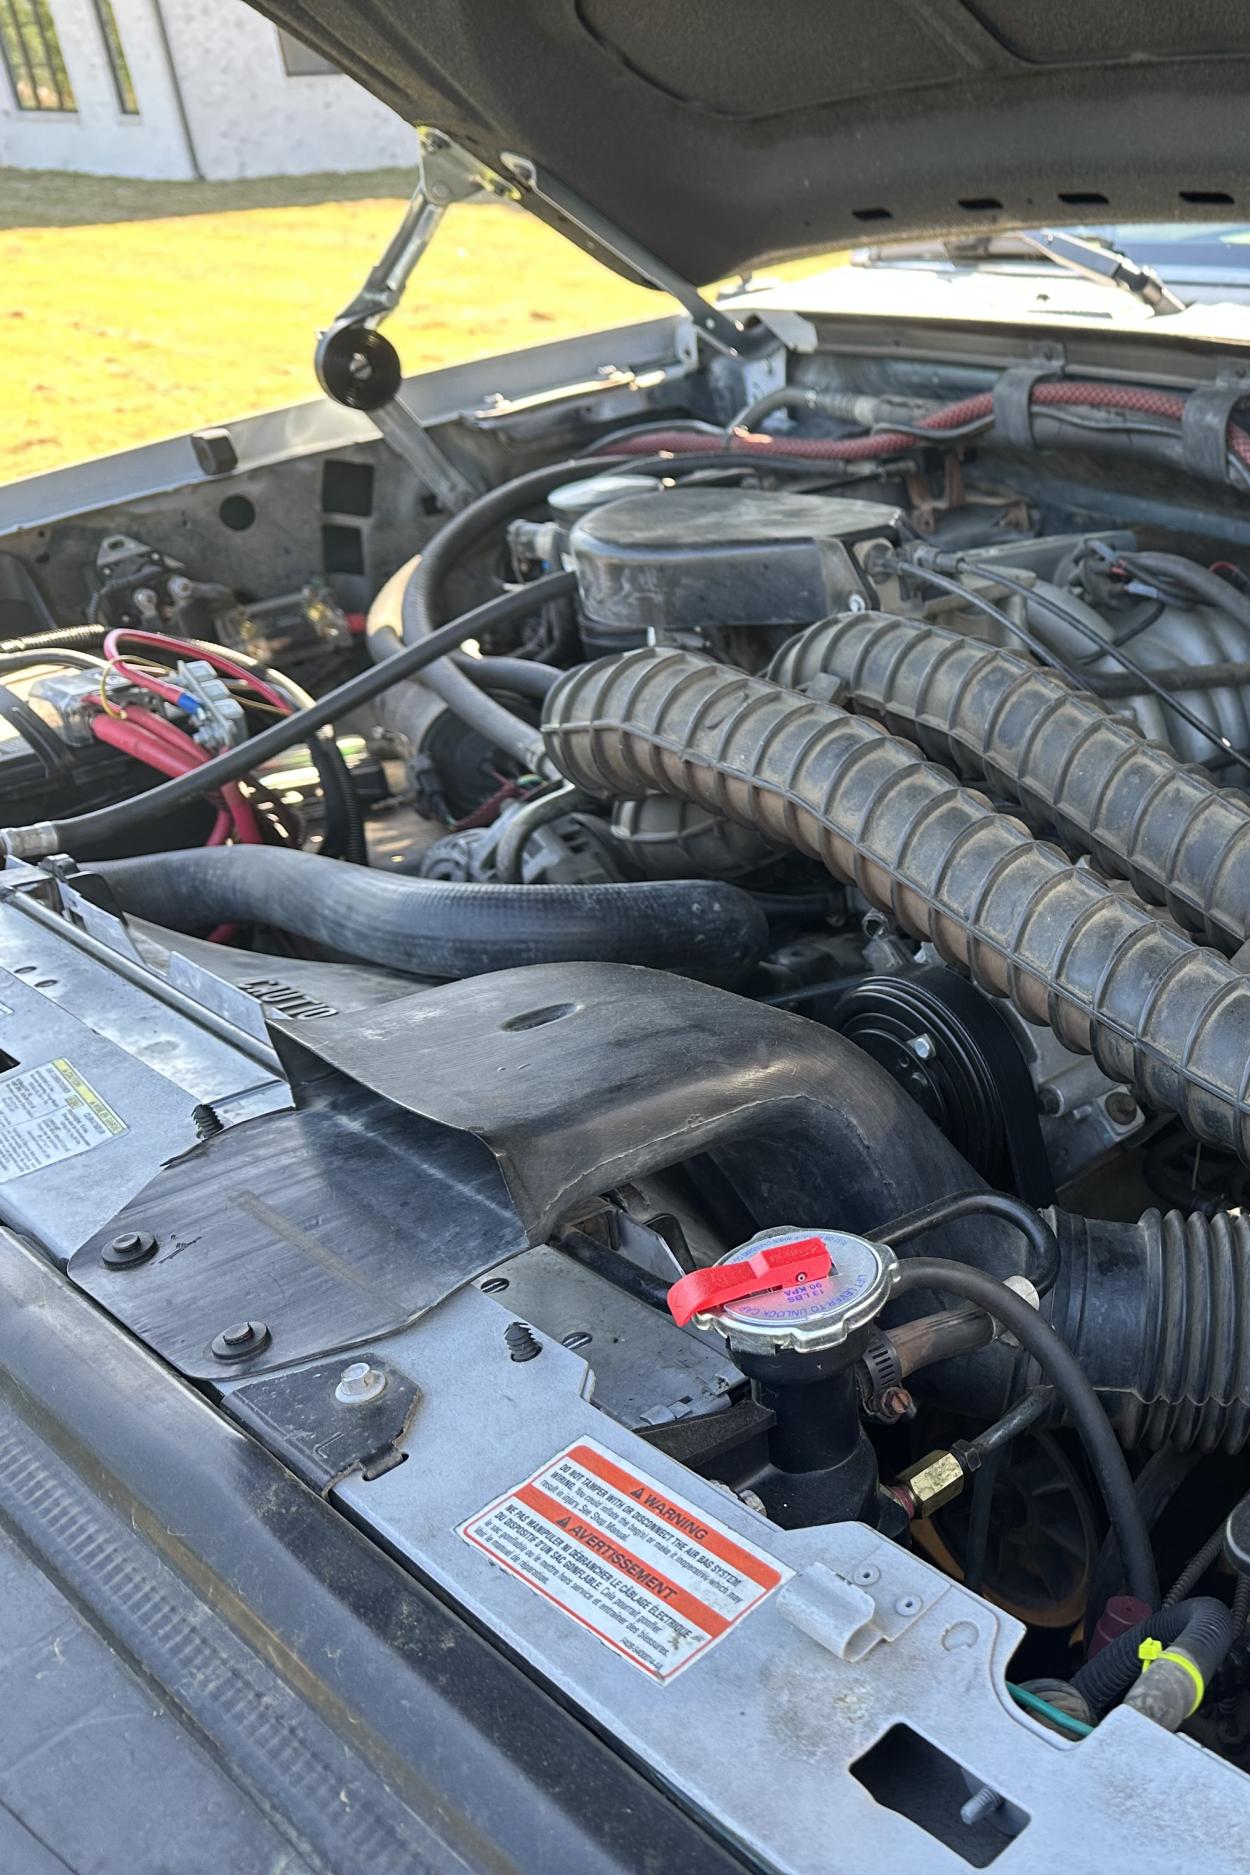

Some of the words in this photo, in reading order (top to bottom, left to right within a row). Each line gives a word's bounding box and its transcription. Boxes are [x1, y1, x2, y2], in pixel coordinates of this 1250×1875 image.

[237, 978, 339, 1020] CAUTIO
[764, 1307, 808, 1319] UNLOCK
[783, 1286, 808, 1296] KPA
[787, 1293, 811, 1303] LBS
[811, 1304, 827, 1314] TO
[828, 1287, 858, 1307] LEVER
[539, 1478, 560, 1493] result
[577, 1504, 594, 1516] See
[587, 1511, 608, 1527] Shop
[549, 1470, 577, 1490] WIRING.
[573, 1487, 588, 1497] You
[583, 1493, 603, 1507] could
[616, 1516, 631, 1526] the
[641, 1494, 710, 1540] WARNING
[558, 1463, 572, 1473] DO
[567, 1469, 584, 1481] NOT
[579, 1477, 609, 1497] TAMPER
[604, 1494, 625, 1508] WITH
[621, 1505, 635, 1515] OR
[630, 1511, 674, 1541] DISCONNECT
[670, 1537, 688, 1550] THE
[683, 1546, 700, 1559] AIR
[696, 1554, 714, 1568] BAG
[710, 1564, 742, 1587] SYSTEM
[489, 1523, 504, 1534] sac
[556, 1571, 575, 1585] hors
[493, 1511, 507, 1521] DU
[502, 1517, 538, 1543] DISPOSITIF
[533, 1539, 554, 1554] D'UN
[548, 1550, 567, 1564] SAC
[561, 1560, 603, 1590] GONFLABLE.
[599, 1587, 618, 1601] Cela
[504, 1503, 519, 1514] NE
[513, 1510, 530, 1522] PAS
[525, 1518, 564, 1547] MANIPULER
[559, 1543, 572, 1552] NI
[567, 1547, 615, 1581] DÉBRANCHER
[608, 1577, 622, 1588] LE
[617, 1582, 654, 1609] CÂBLAGE
[647, 1603, 695, 1638] ÉLECTRIQUE
[567, 1523, 677, 1601] AVERTISSEMENT
